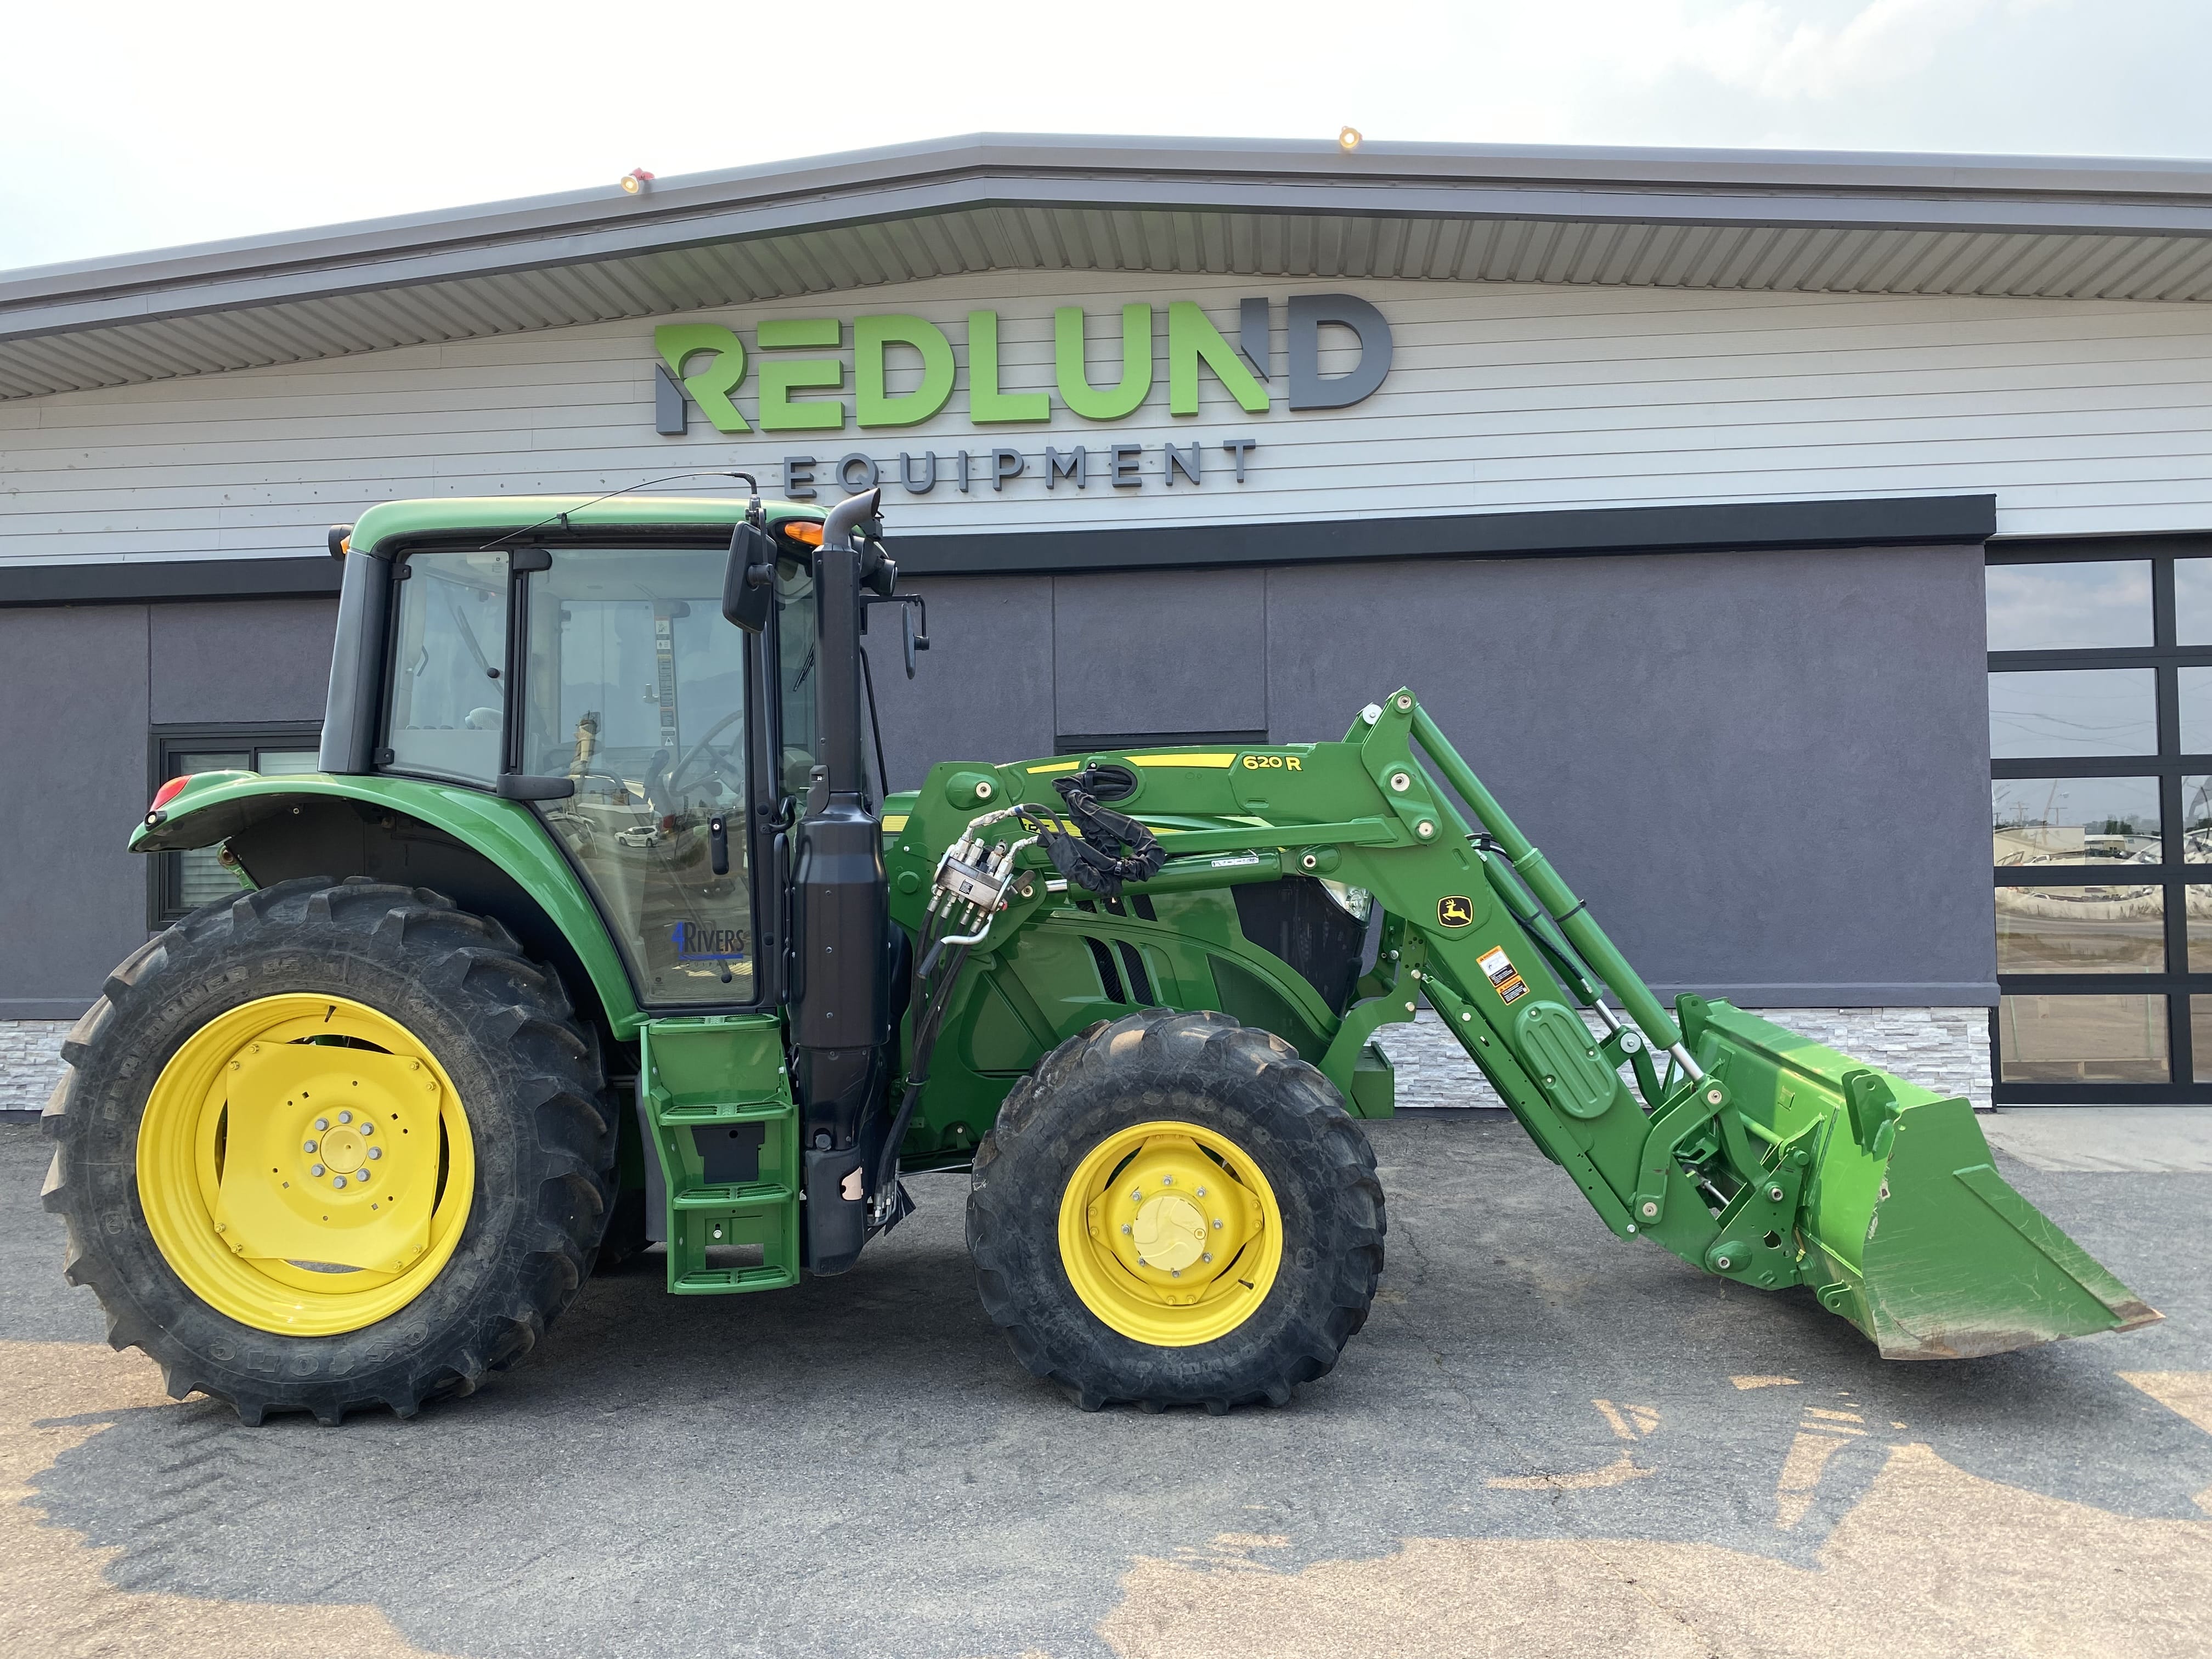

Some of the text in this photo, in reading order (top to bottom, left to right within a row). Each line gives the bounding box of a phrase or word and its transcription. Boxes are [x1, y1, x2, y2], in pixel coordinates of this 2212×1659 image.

[654, 294, 1393, 435] REDLUND
[784, 439, 1256, 499] EQUIPMENT
[1242, 755, 1304, 771] 620 R
